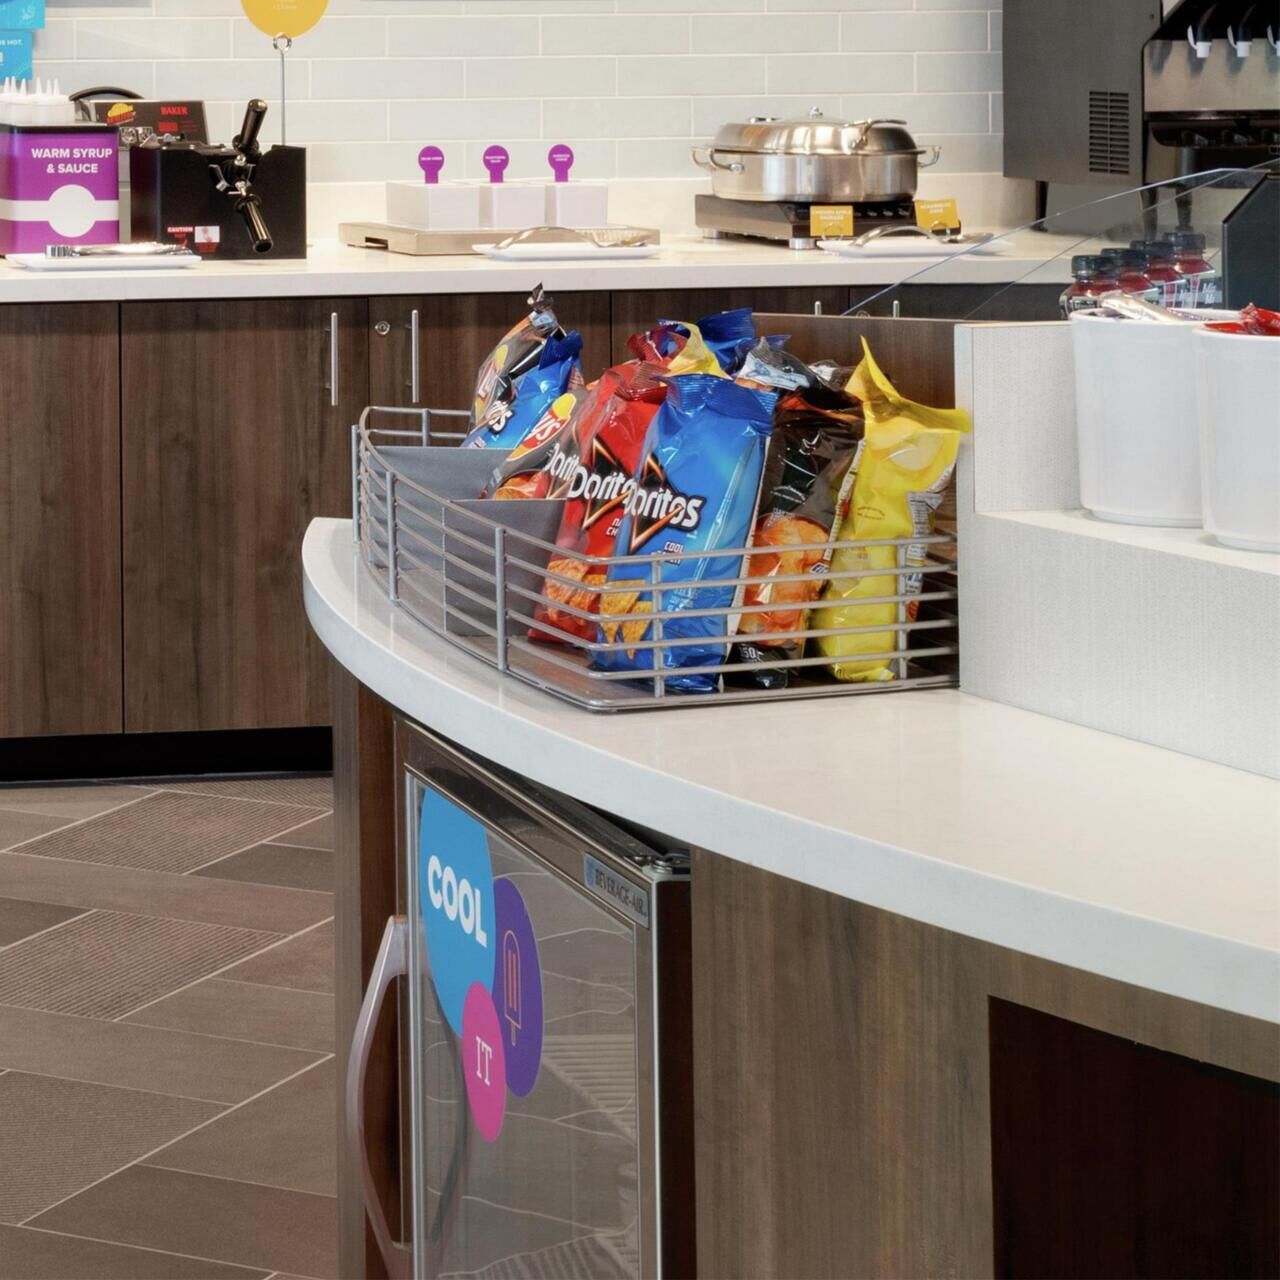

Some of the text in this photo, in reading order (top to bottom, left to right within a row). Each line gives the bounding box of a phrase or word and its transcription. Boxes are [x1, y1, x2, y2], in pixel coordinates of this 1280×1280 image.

[31, 148, 113, 158] WARM SYRUP
[46, 163, 99, 173] & SAUCE
[663, 541, 683, 553] COOL
[428, 855, 487, 948] COOL
[594, 867, 646, 916] BEVERAGE-AIR
[475, 1035, 492, 1087] IT
